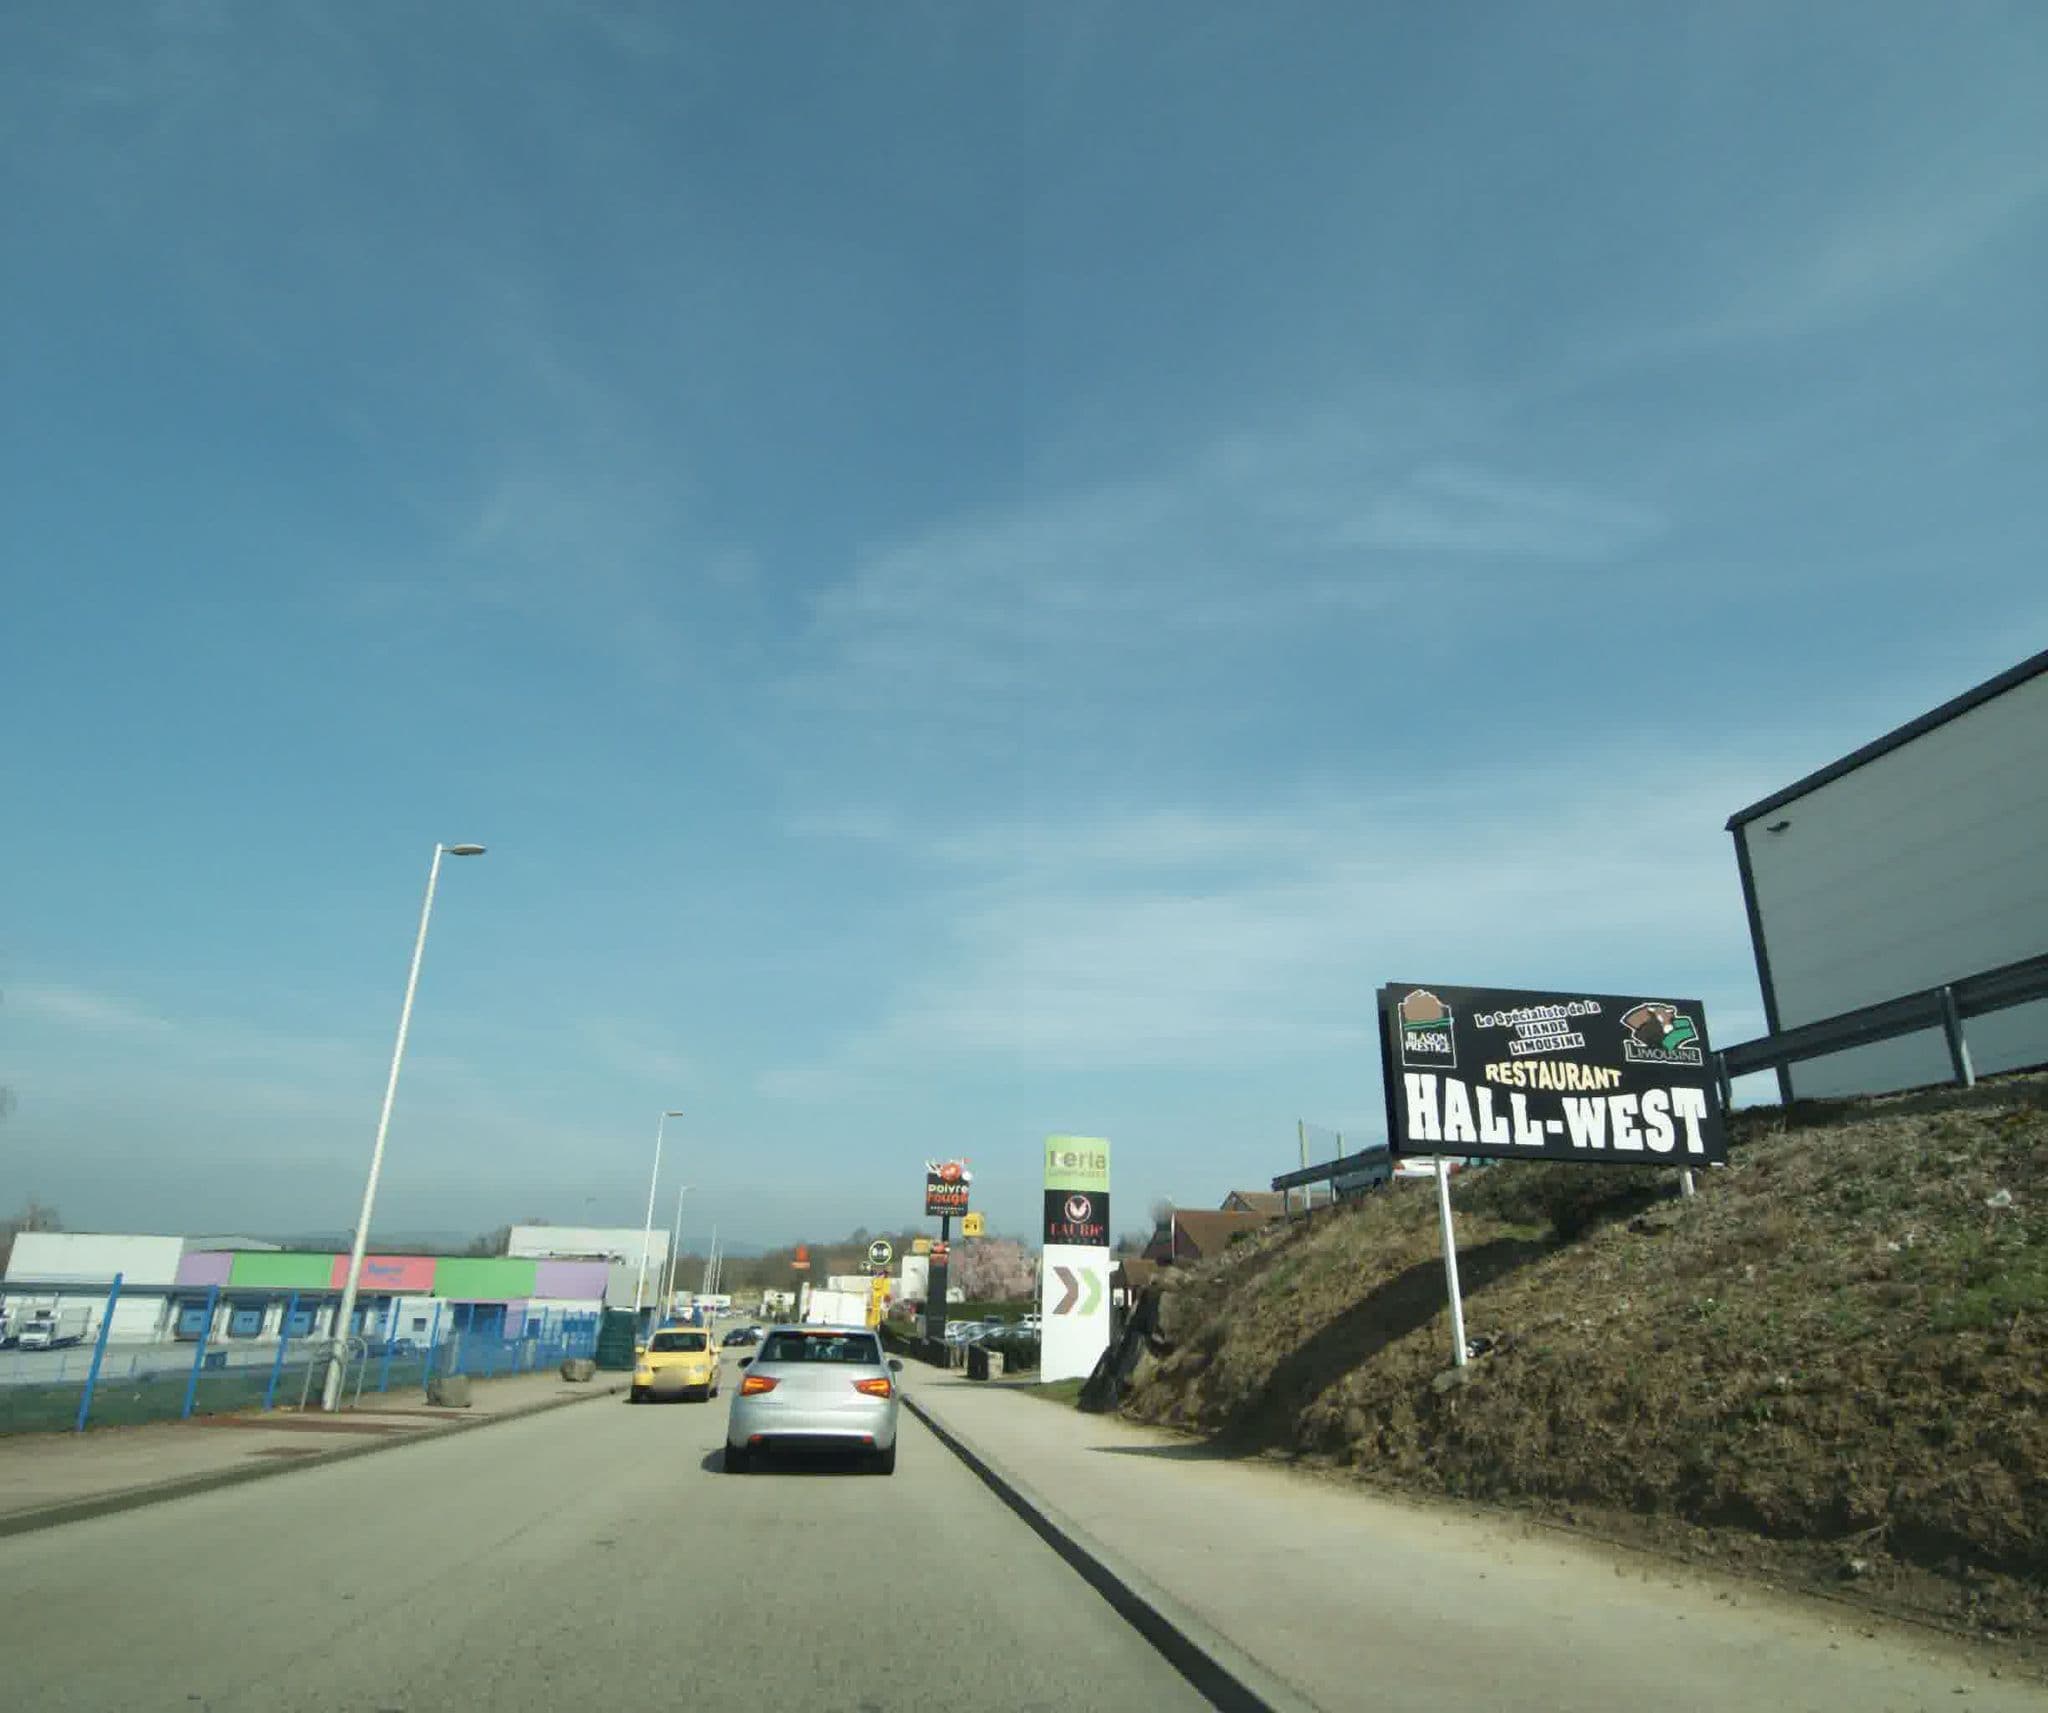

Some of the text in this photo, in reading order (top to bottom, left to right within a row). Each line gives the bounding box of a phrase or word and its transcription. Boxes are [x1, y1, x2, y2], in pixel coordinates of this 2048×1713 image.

[1474, 1013, 1494, 1028] Le
[1568, 1001, 1584, 1016] de
[1583, 1000, 1601, 1014] la
[1407, 1032, 1447, 1043] BLASON
[1515, 1019, 1569, 1038] VIANDE
[1509, 1032, 1585, 1056] LIMOUSINE
[1485, 1060, 1624, 1092] RESTAURANT
[1403, 1072, 1708, 1154] HALL-WEST
